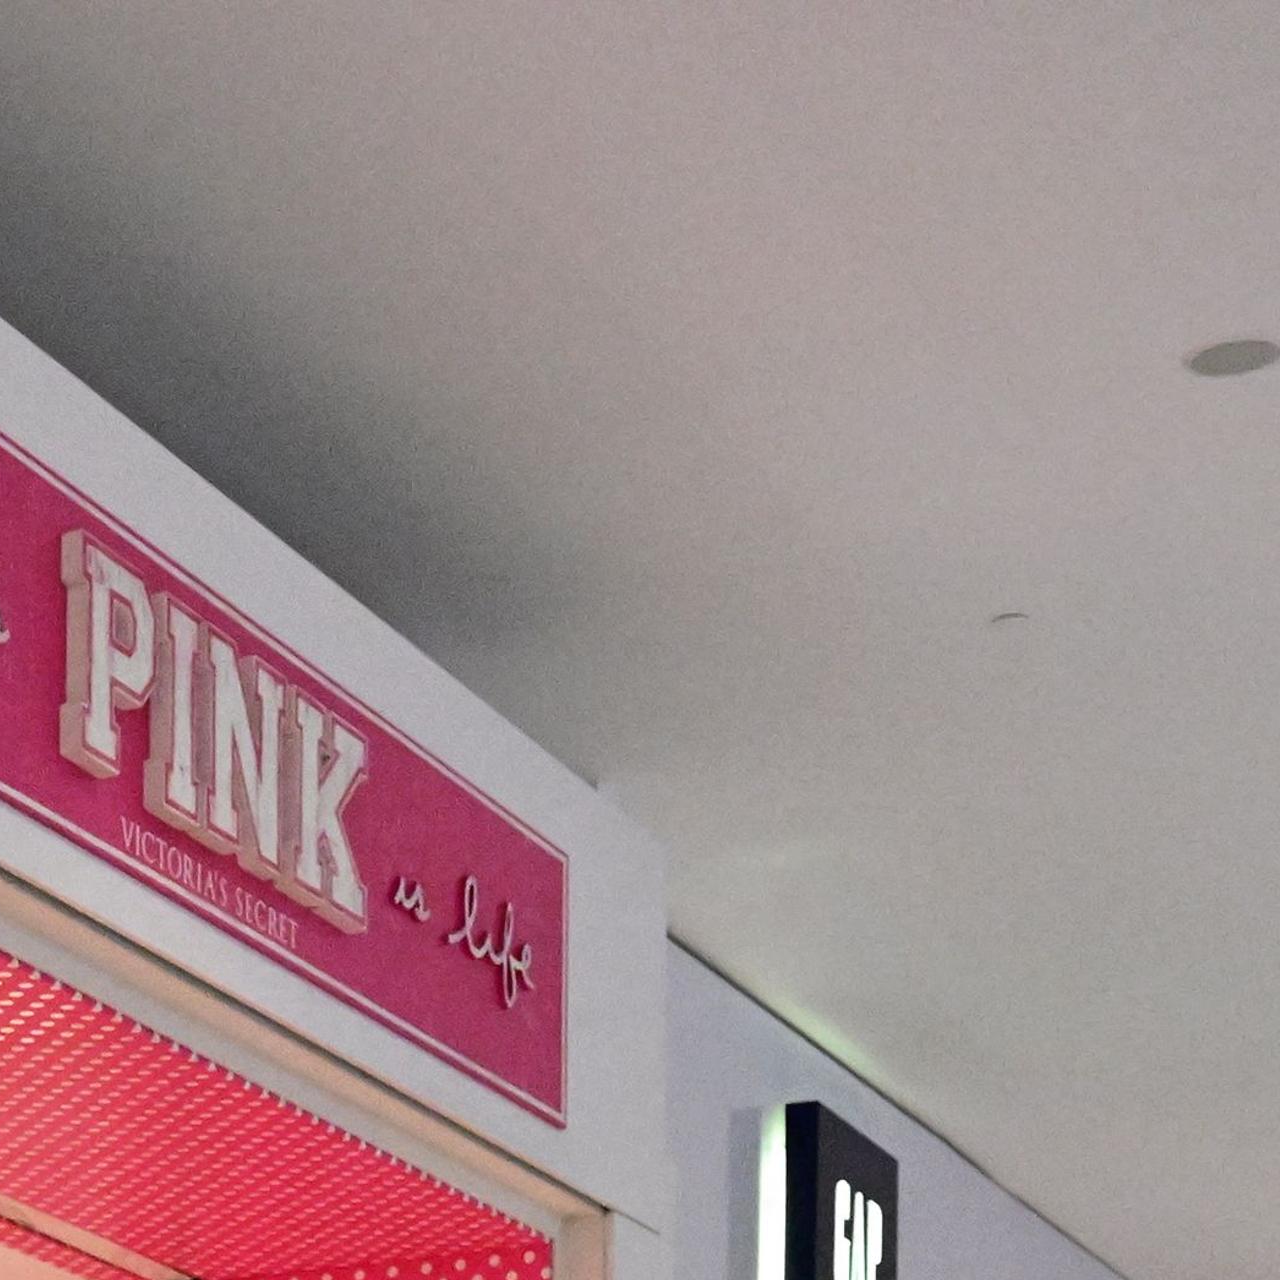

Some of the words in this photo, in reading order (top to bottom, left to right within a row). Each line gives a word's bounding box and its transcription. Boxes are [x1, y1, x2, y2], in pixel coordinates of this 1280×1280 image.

[60, 527, 369, 934] PINK
[394, 875, 431, 923] is
[447, 874, 536, 1009] life
[120, 815, 228, 908] VICTORIA'S
[235, 887, 299, 949] SECRET
